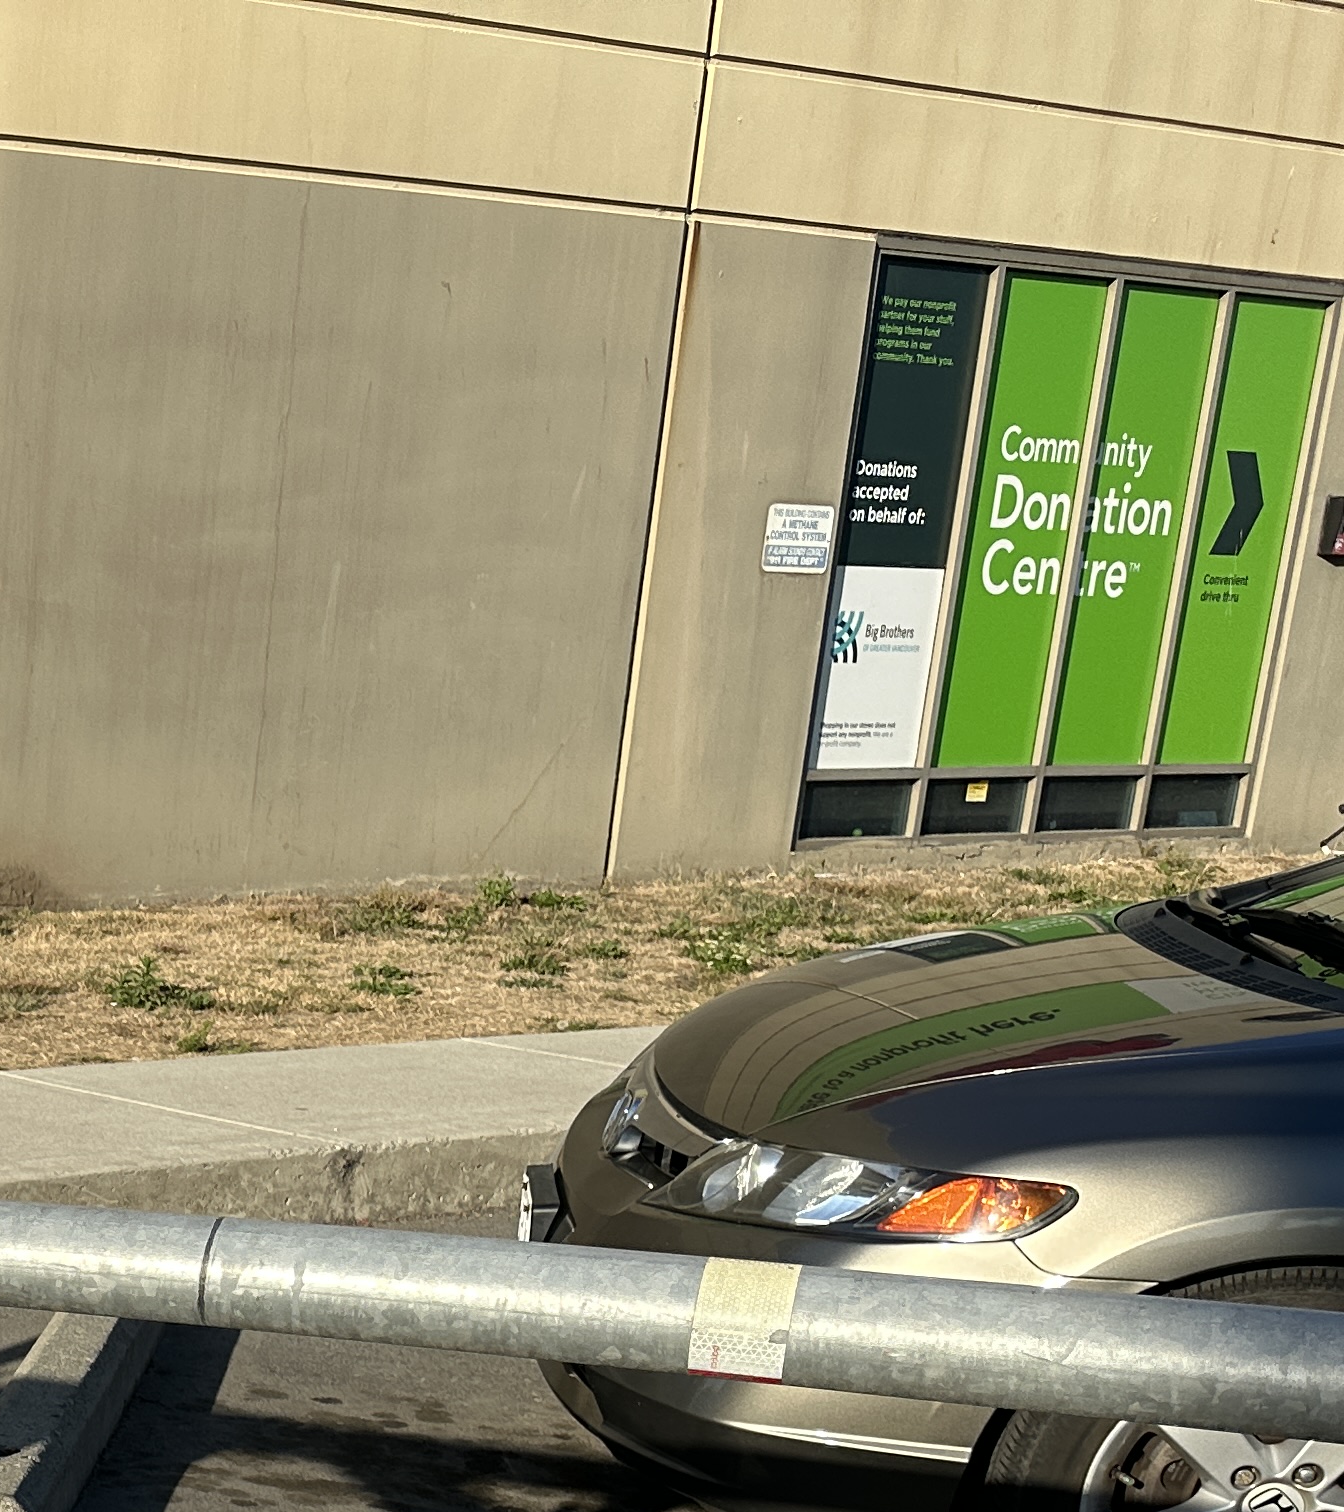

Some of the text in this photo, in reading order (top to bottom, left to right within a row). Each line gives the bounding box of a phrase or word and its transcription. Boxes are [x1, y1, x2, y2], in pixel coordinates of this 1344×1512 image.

[856, 459, 918, 478] Donations
[852, 484, 910, 503] accepted
[849, 505, 926, 525] on behalf of:
[865, 623, 915, 642] Big Brothers
